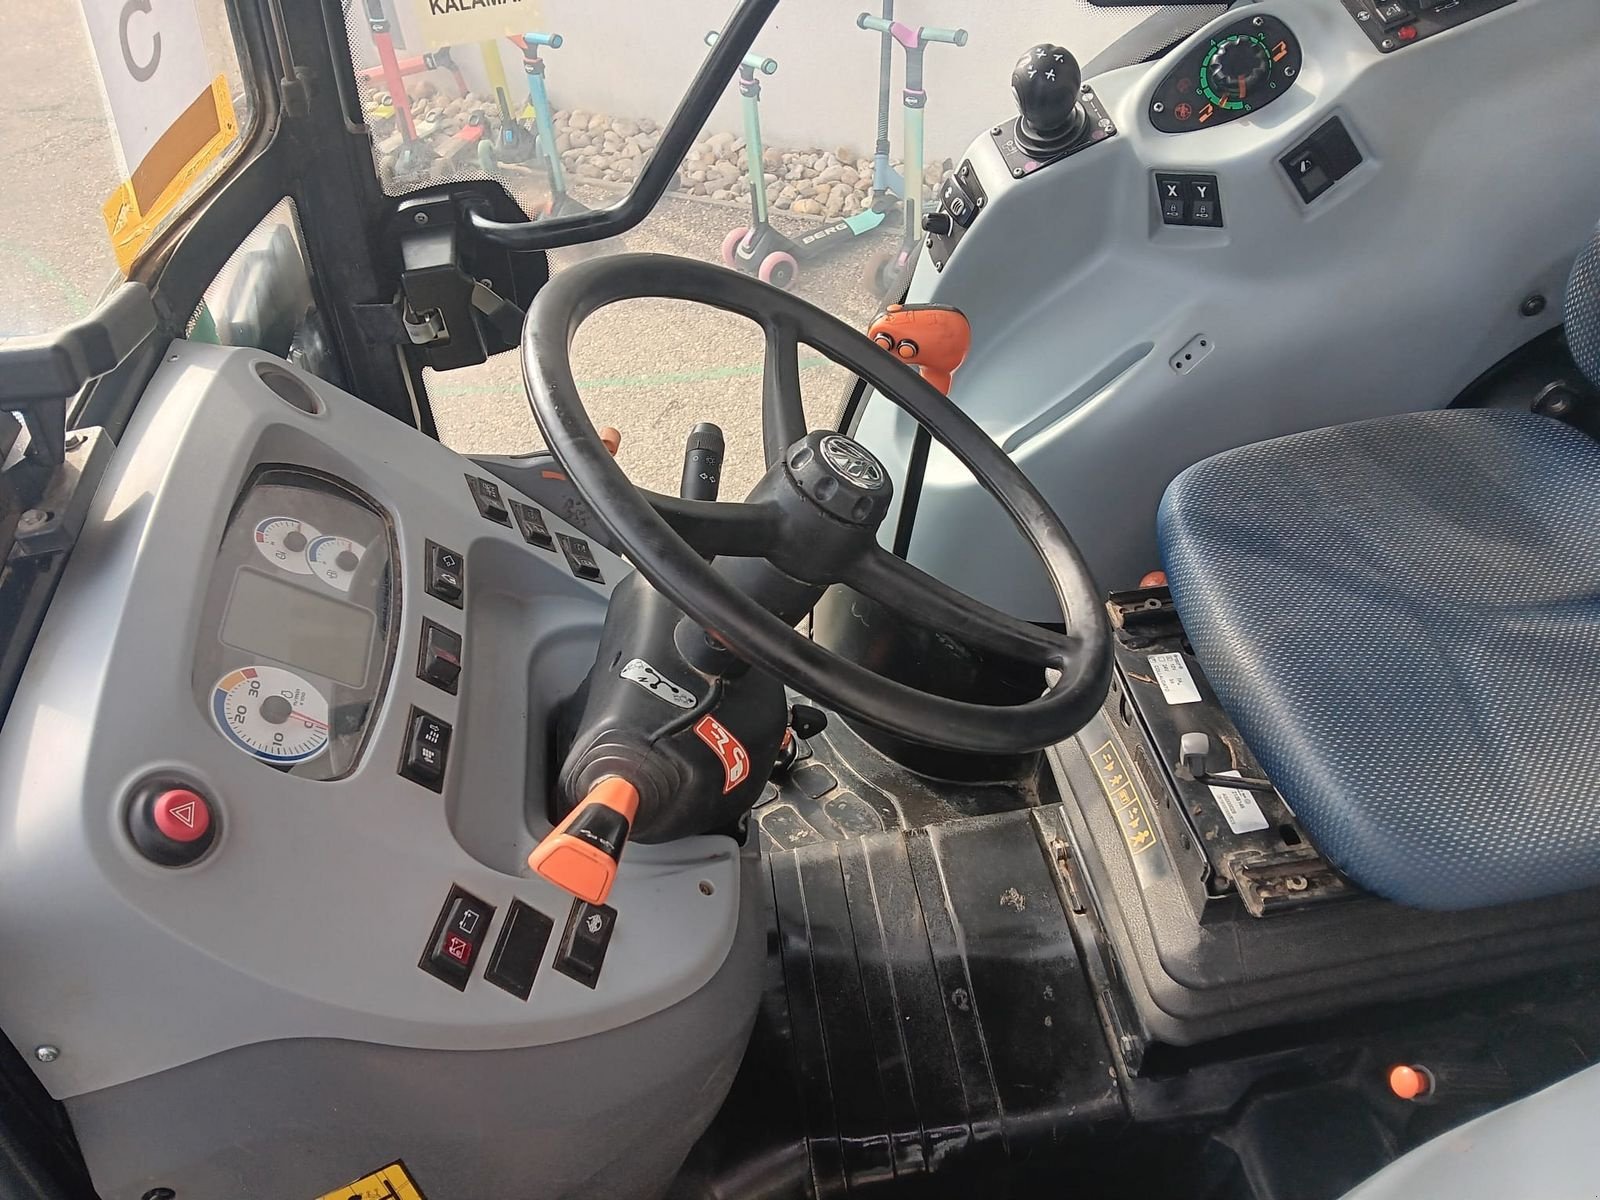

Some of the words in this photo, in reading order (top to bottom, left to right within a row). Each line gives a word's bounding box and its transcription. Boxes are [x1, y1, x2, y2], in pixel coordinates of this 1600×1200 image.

[1167, 184, 1178, 197] X
[1197, 186, 1207, 198] Y
[802, 222, 848, 245] BERG
[248, 680, 261, 698] 30
[233, 705, 247, 724] 20
[272, 732, 284, 747] 10
